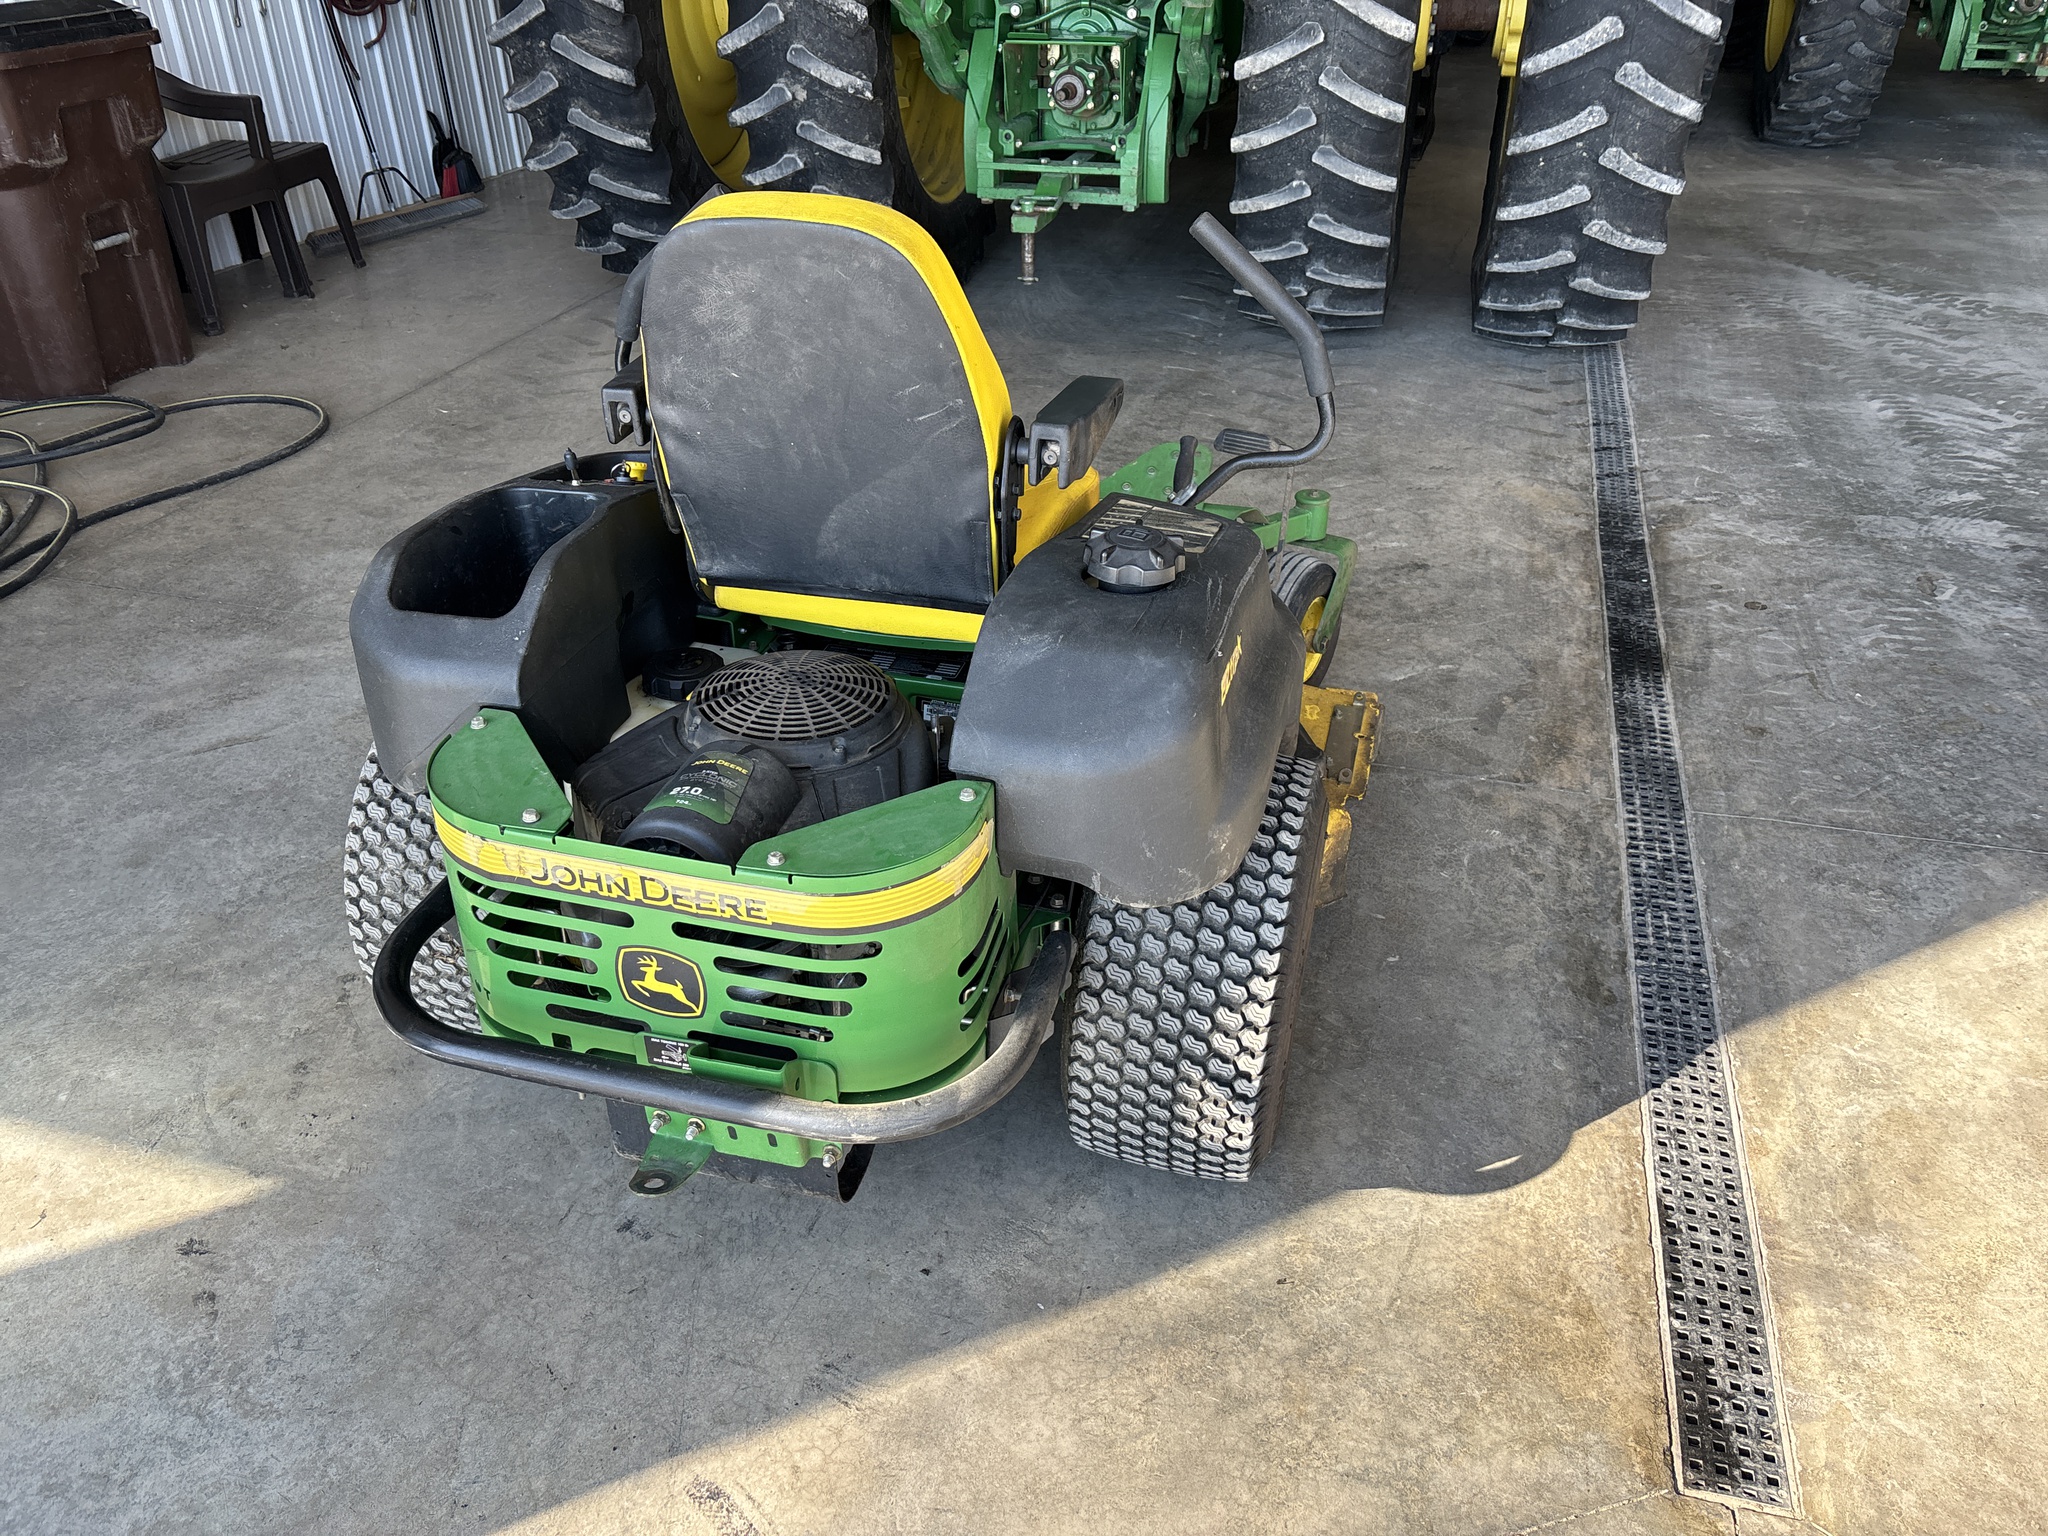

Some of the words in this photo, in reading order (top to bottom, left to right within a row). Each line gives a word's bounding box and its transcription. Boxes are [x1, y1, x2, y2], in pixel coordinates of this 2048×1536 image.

[717, 759, 748, 774] DEERE
[680, 772, 738, 788] CYCLONIC
[669, 786, 703, 795] 27.0
[531, 858, 631, 898] JOHN
[639, 875, 768, 921] DEERE
